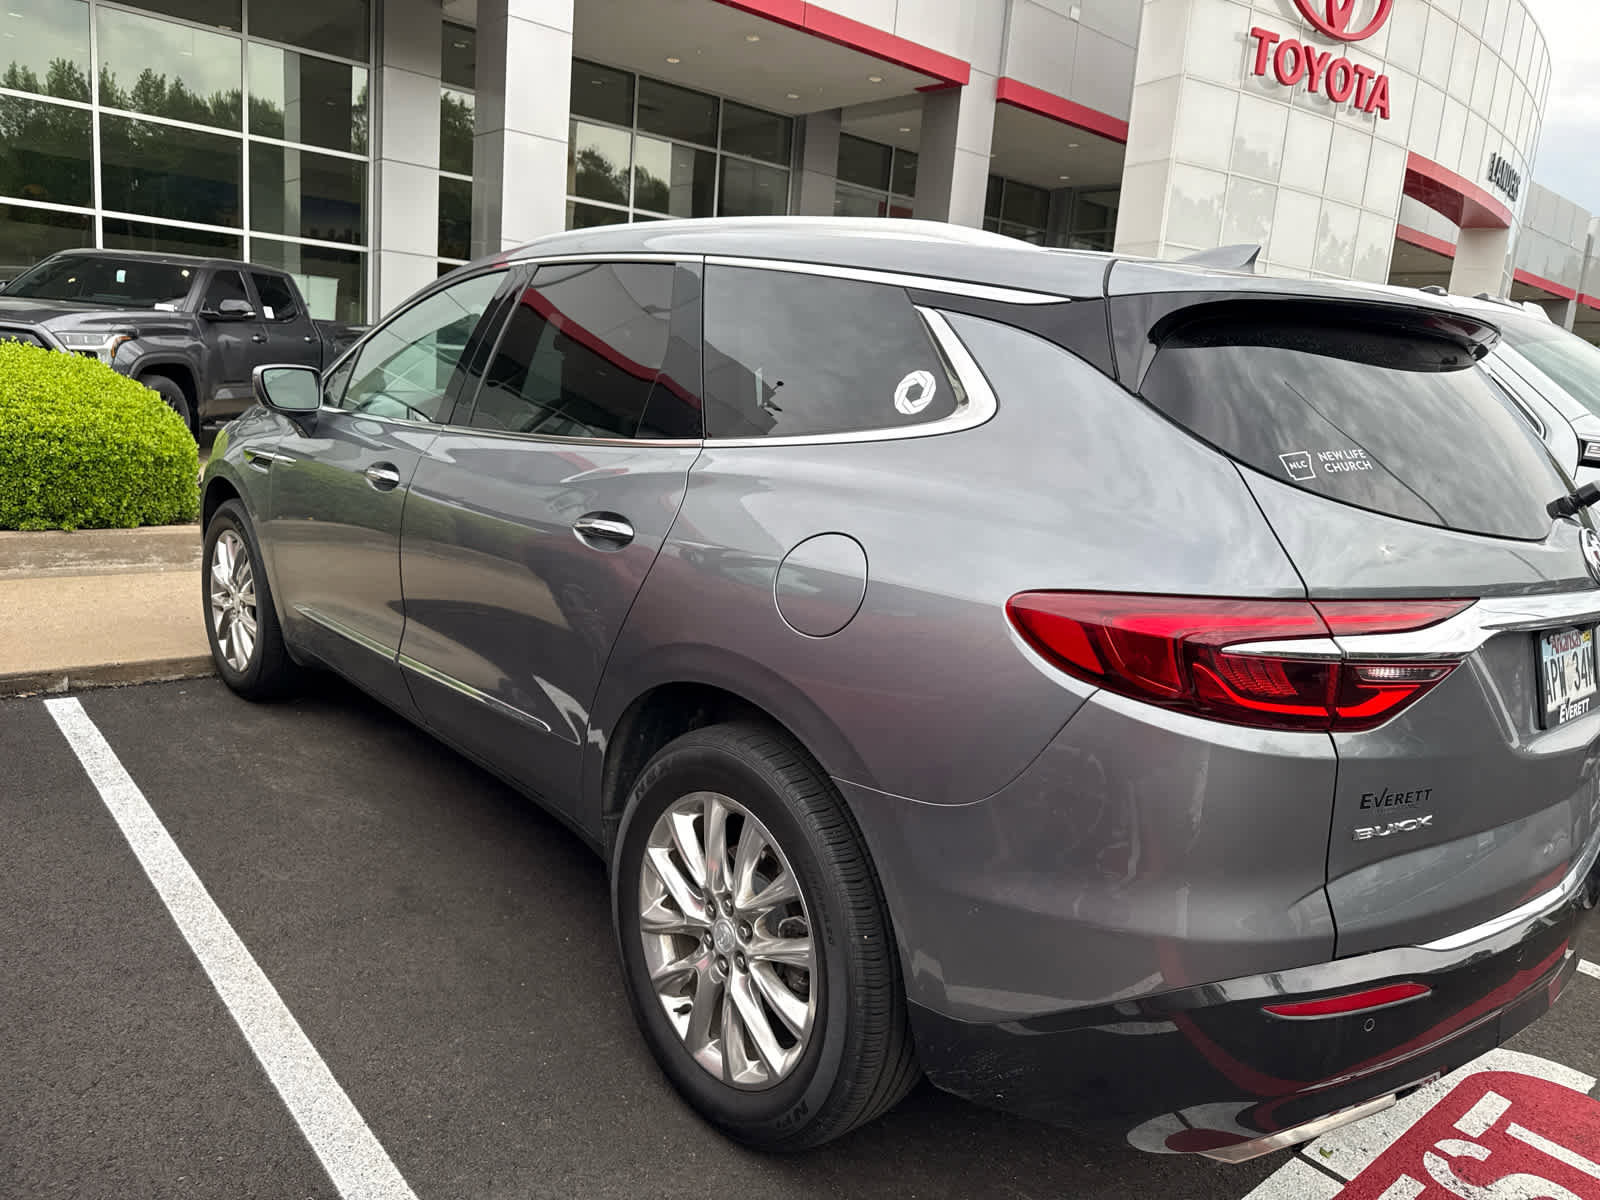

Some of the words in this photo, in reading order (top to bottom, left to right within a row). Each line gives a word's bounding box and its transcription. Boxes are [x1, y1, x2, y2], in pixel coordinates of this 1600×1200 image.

[1251, 27, 1390, 120] TOYOTA
[1317, 450, 1343, 462] NEW
[1343, 449, 1367, 460] LIFE
[1288, 460, 1308, 470] NLC
[1324, 460, 1373, 473] CHURCH
[1352, 814, 1433, 841] BUICK
